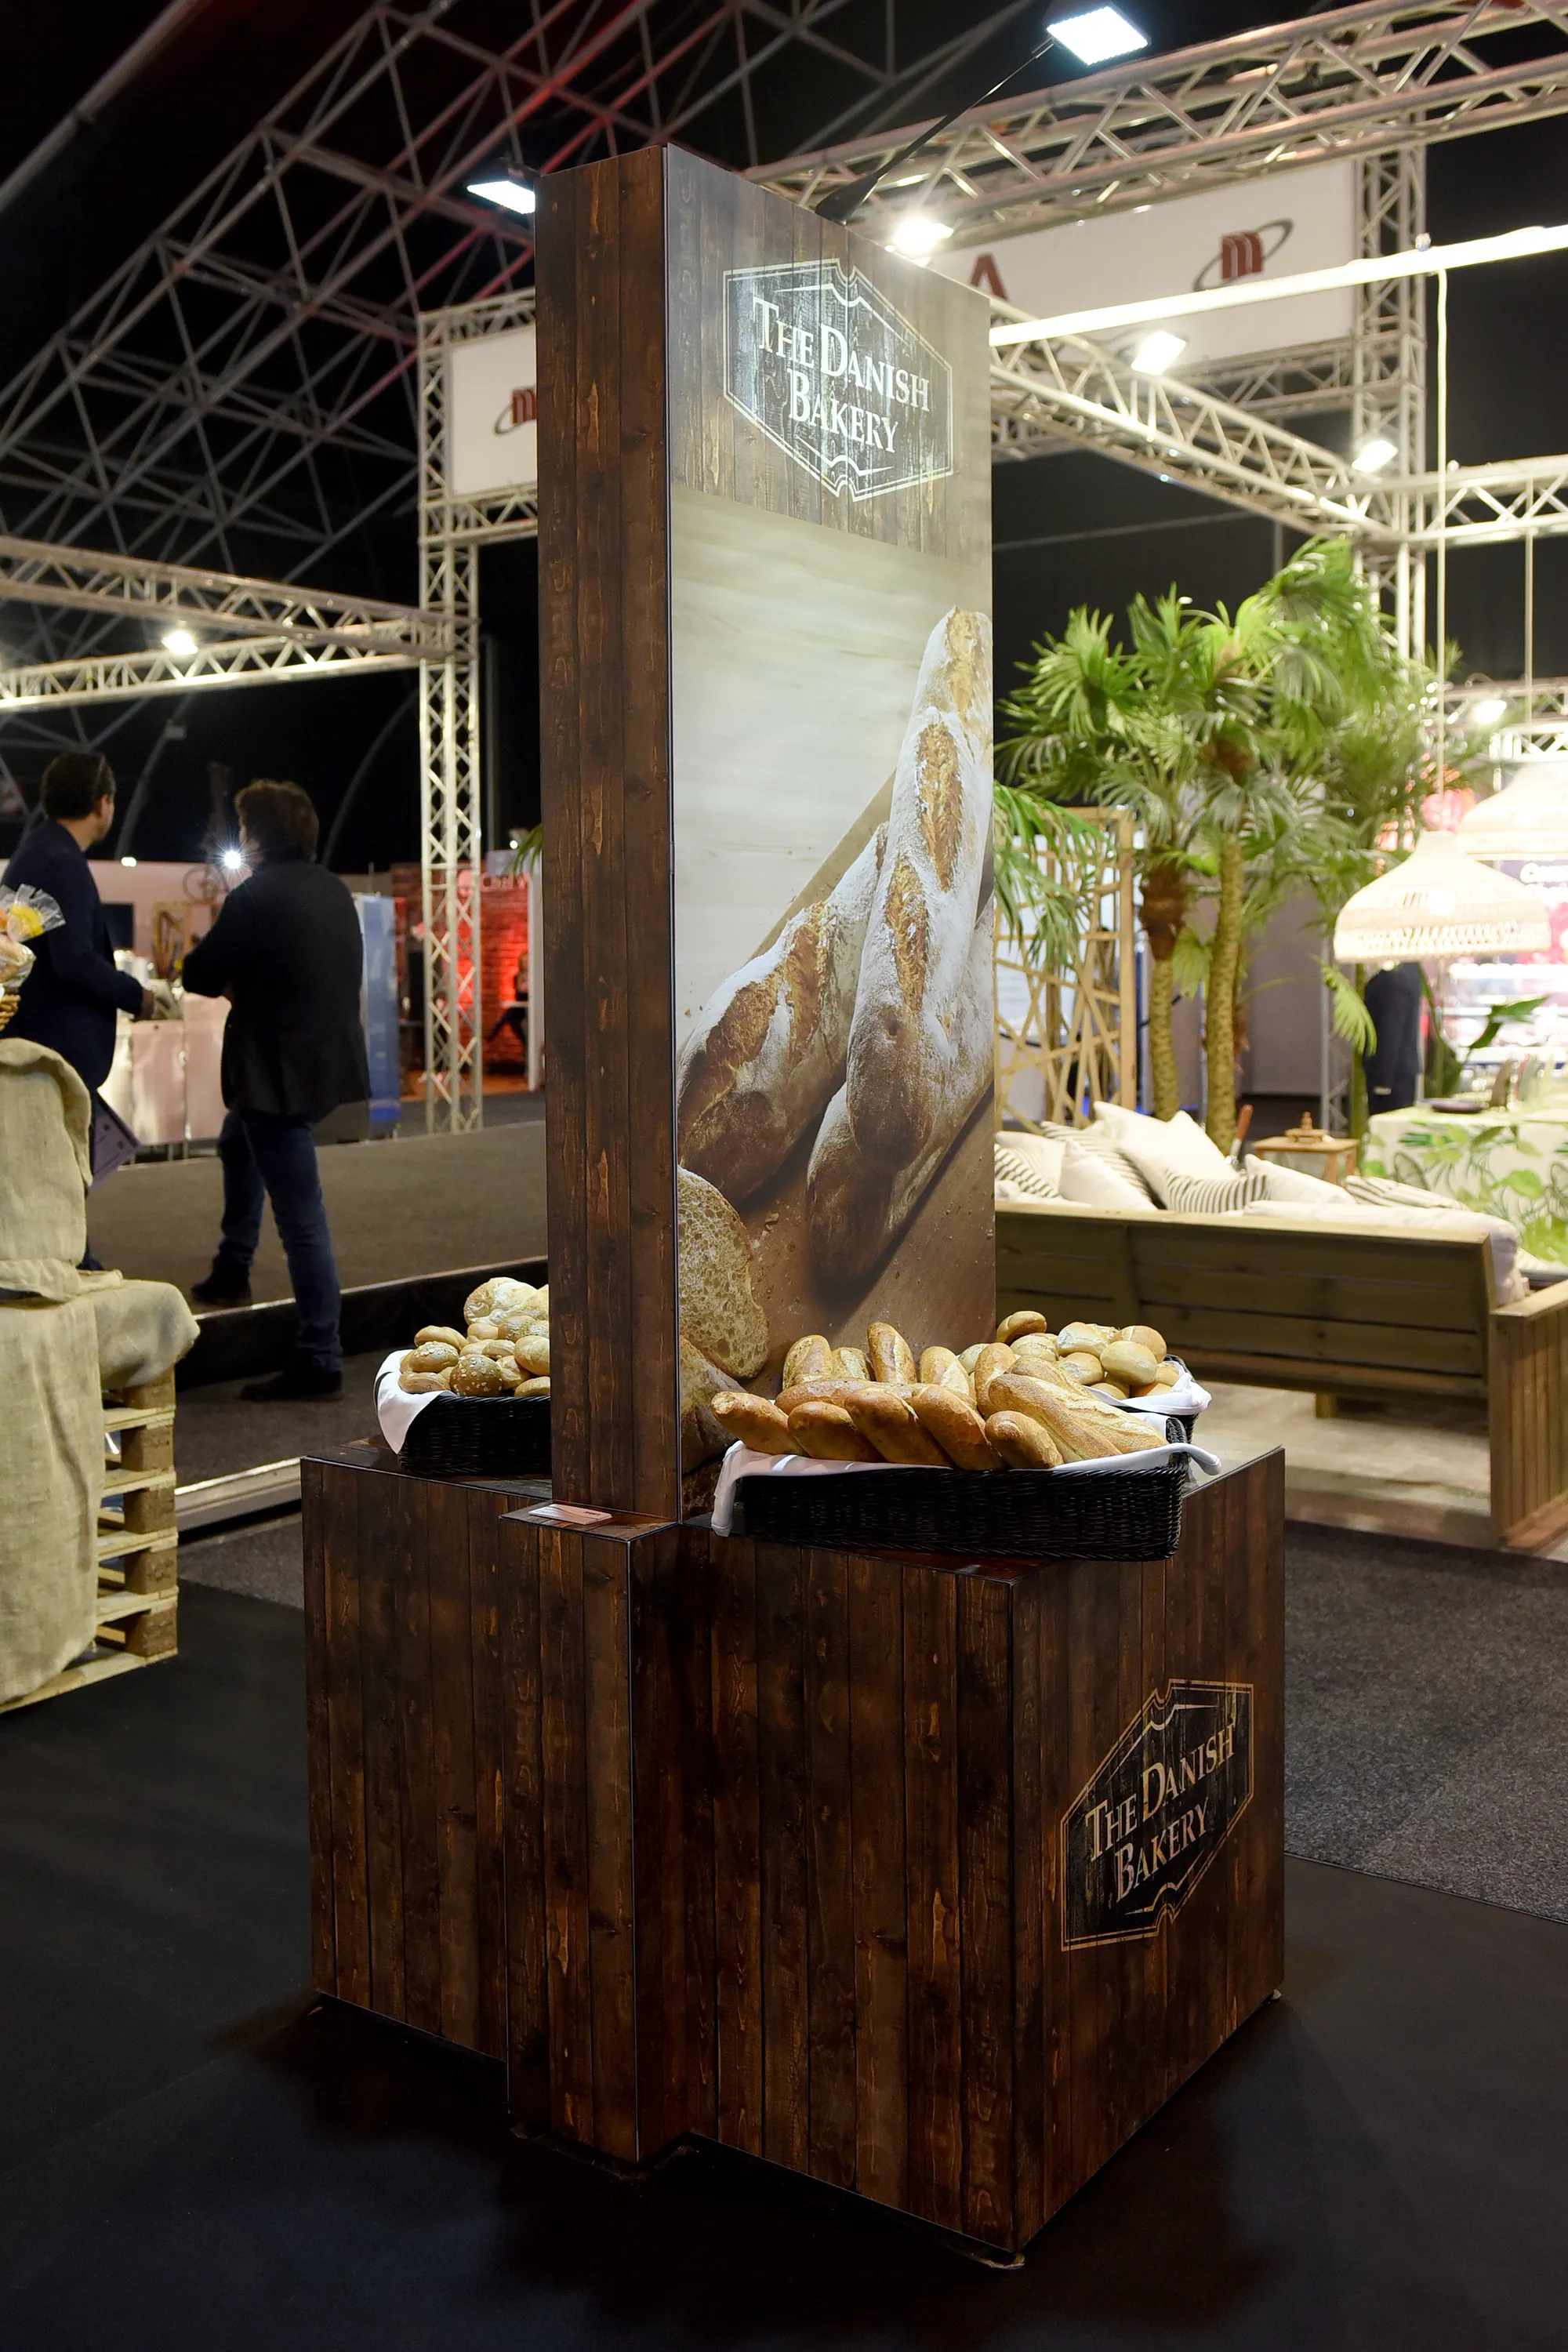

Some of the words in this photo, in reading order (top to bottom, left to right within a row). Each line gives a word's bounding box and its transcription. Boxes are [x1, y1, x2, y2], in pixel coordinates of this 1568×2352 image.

[752, 296, 814, 368] THE
[820, 323, 930, 412] DANISH
[786, 368, 898, 453] BAKERY
[1085, 1793, 1137, 1862] THE
[1142, 1722, 1236, 1822] DANISH
[1115, 1796, 1209, 1903] BAKERY
